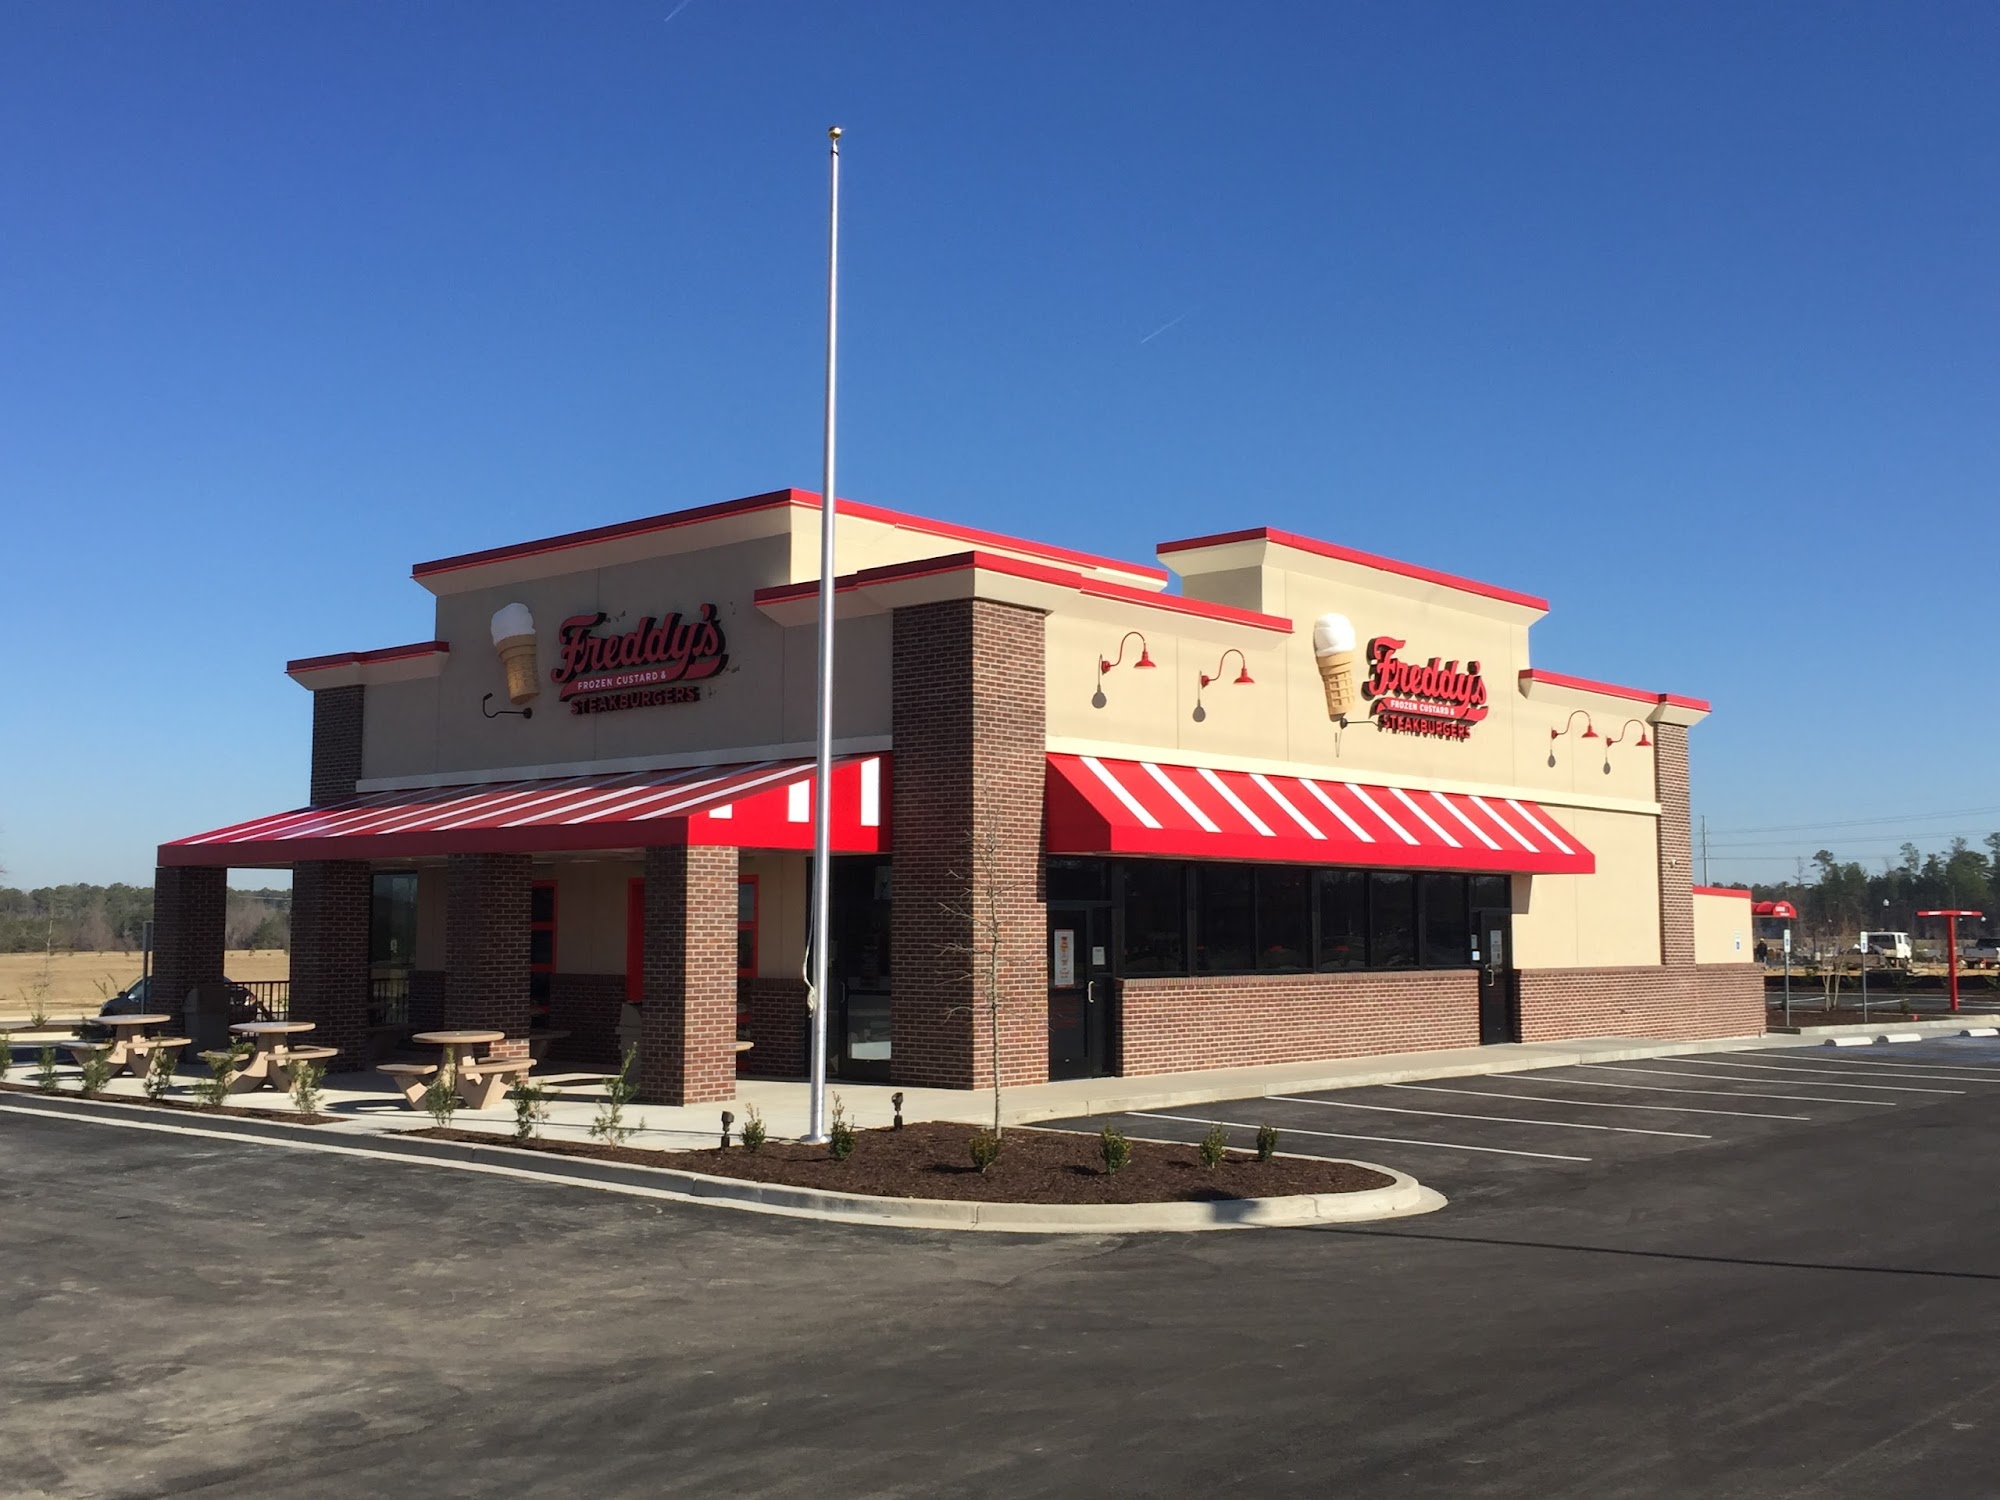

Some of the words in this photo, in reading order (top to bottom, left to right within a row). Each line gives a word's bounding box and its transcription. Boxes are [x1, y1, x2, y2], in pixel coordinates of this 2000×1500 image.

[551, 603, 727, 683] Freddy's
[577, 678, 613, 691] FROZEN
[616, 672, 658, 686] CUSTARD
[660, 670, 667, 680] &
[1366, 636, 1487, 710] Freddy's
[571, 686, 698, 715] STEAKBURGERS
[1390, 699, 1418, 711] FROZEN
[1419, 703, 1447, 715] CUSTARD
[1448, 708, 1455, 716] &
[1382, 714, 1471, 739] STEAKBURGERS
